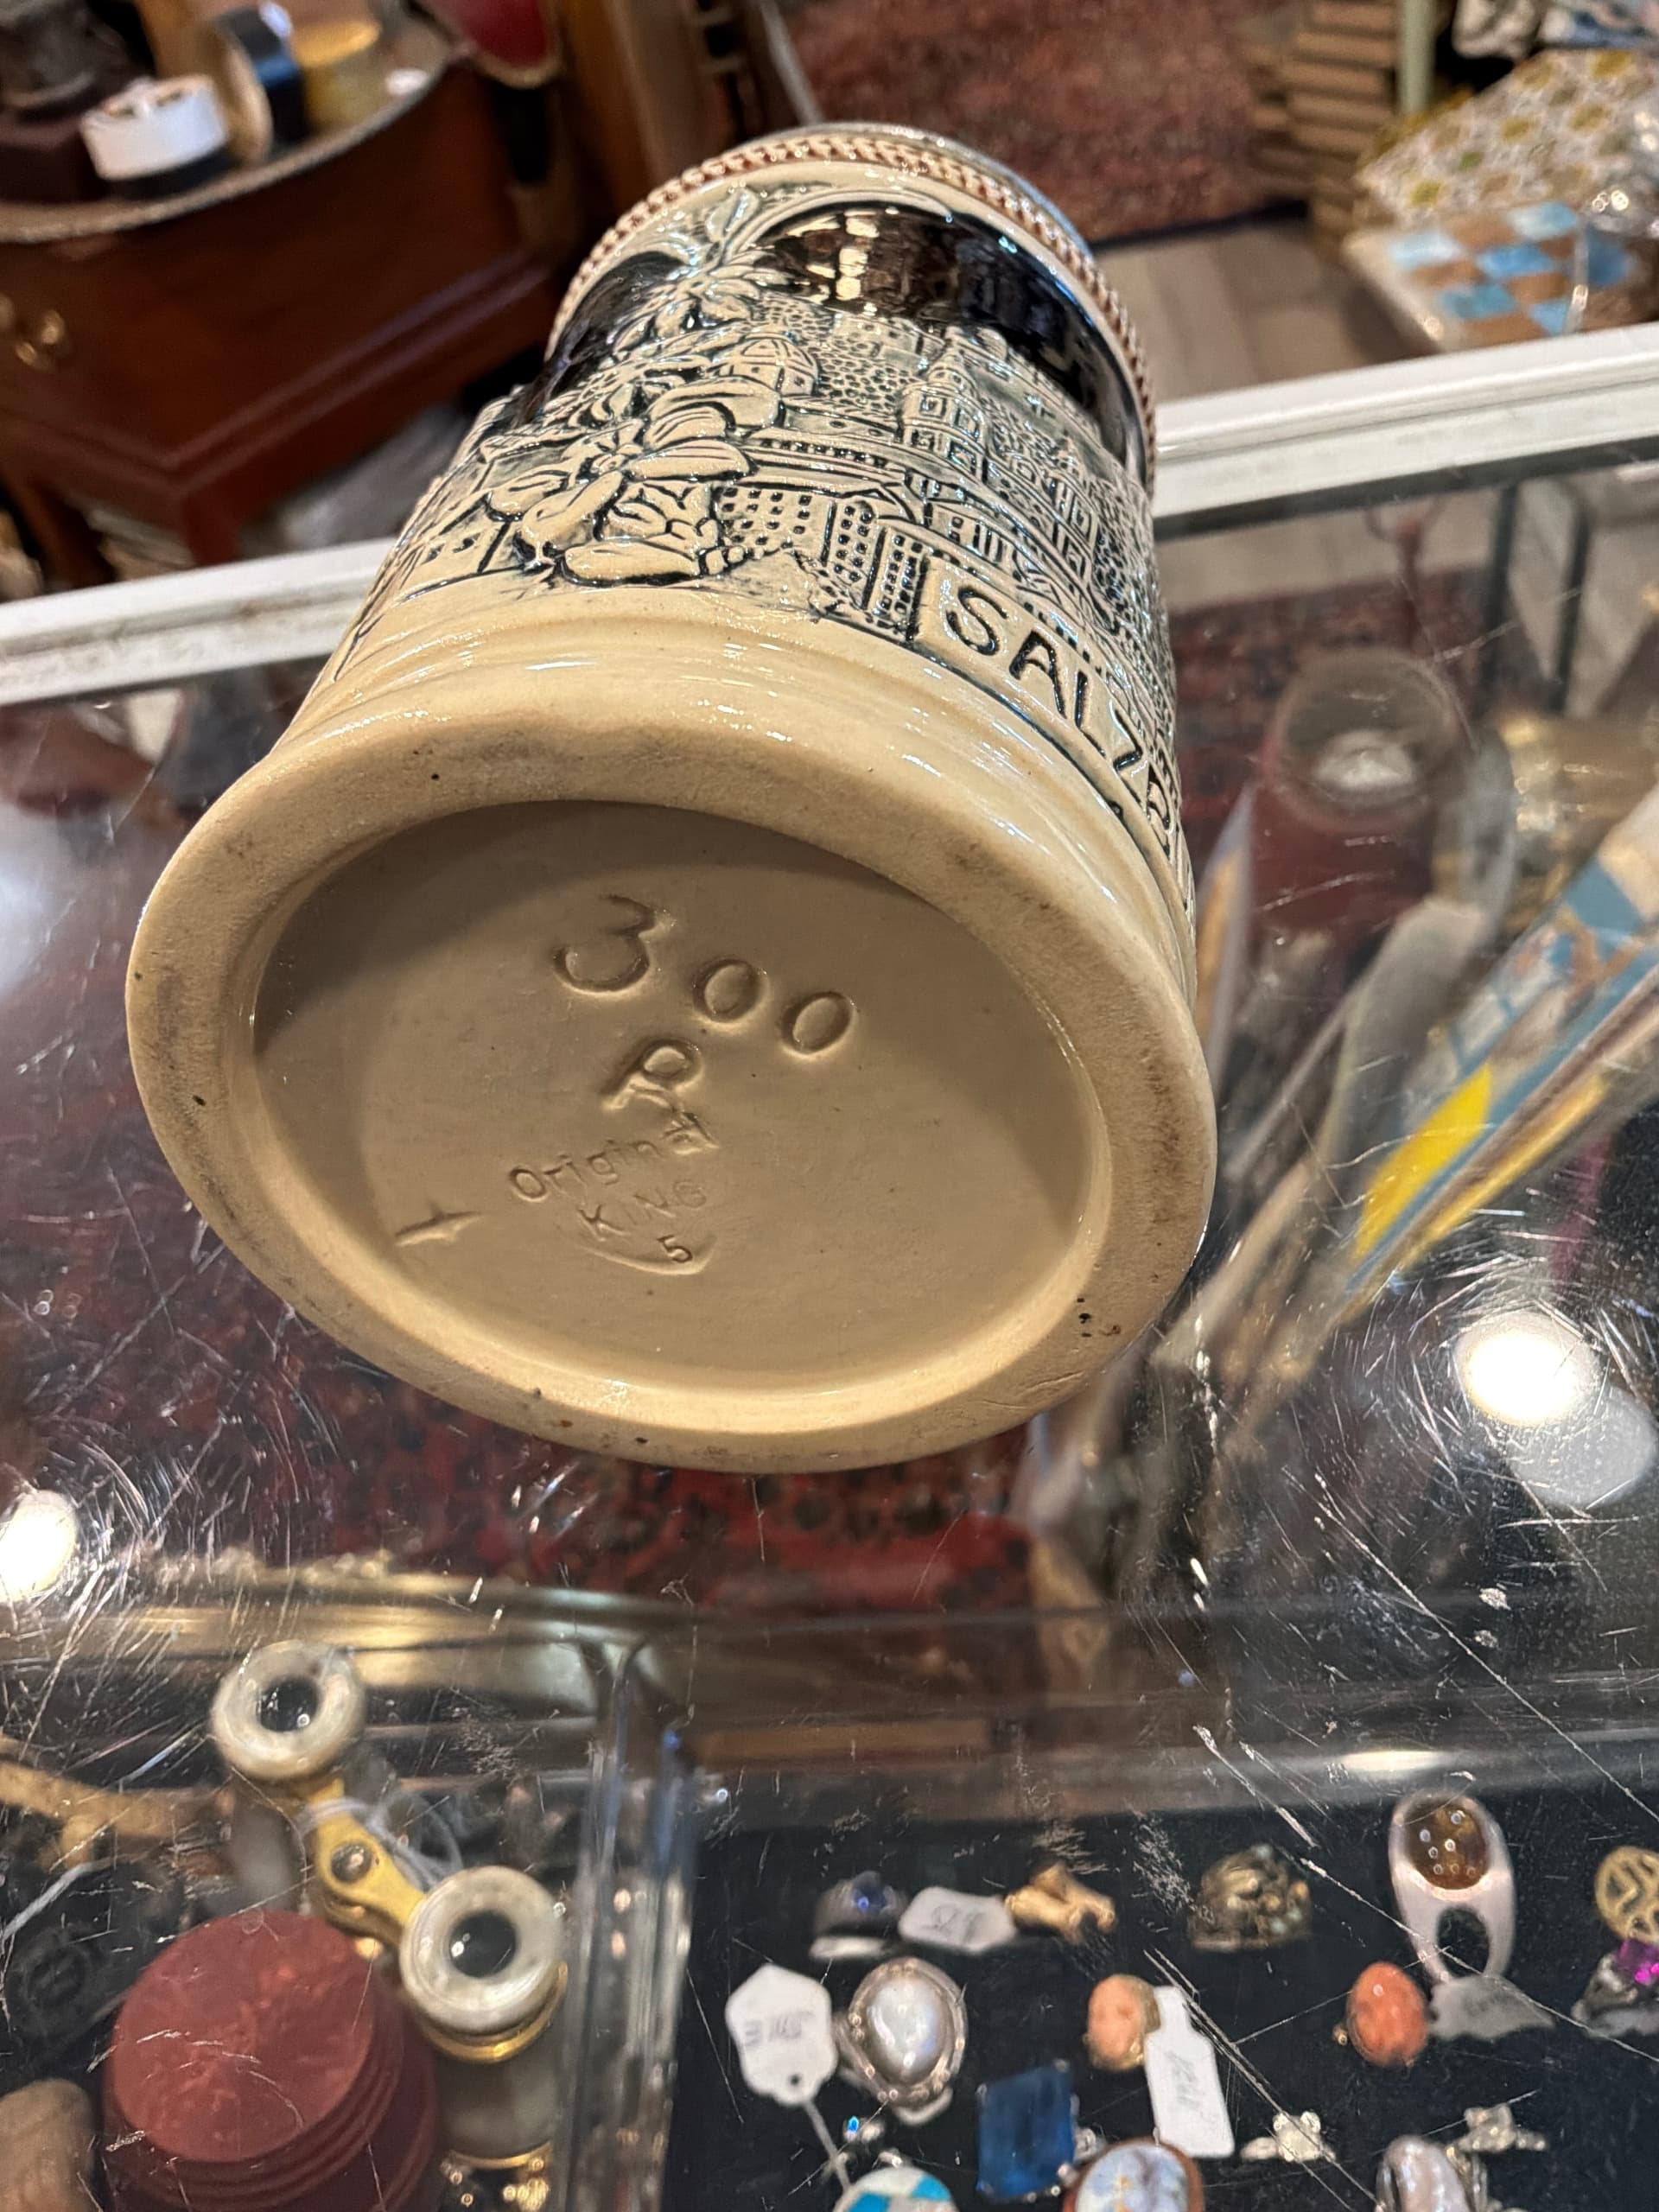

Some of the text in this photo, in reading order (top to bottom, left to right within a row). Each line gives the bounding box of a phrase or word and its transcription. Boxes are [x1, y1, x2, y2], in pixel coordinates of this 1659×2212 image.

[944, 584, 1184, 890] SALZB
[551, 892, 859, 1059] 300
[575, 1180, 709, 1242] KING
[656, 1233, 694, 1264] 5
